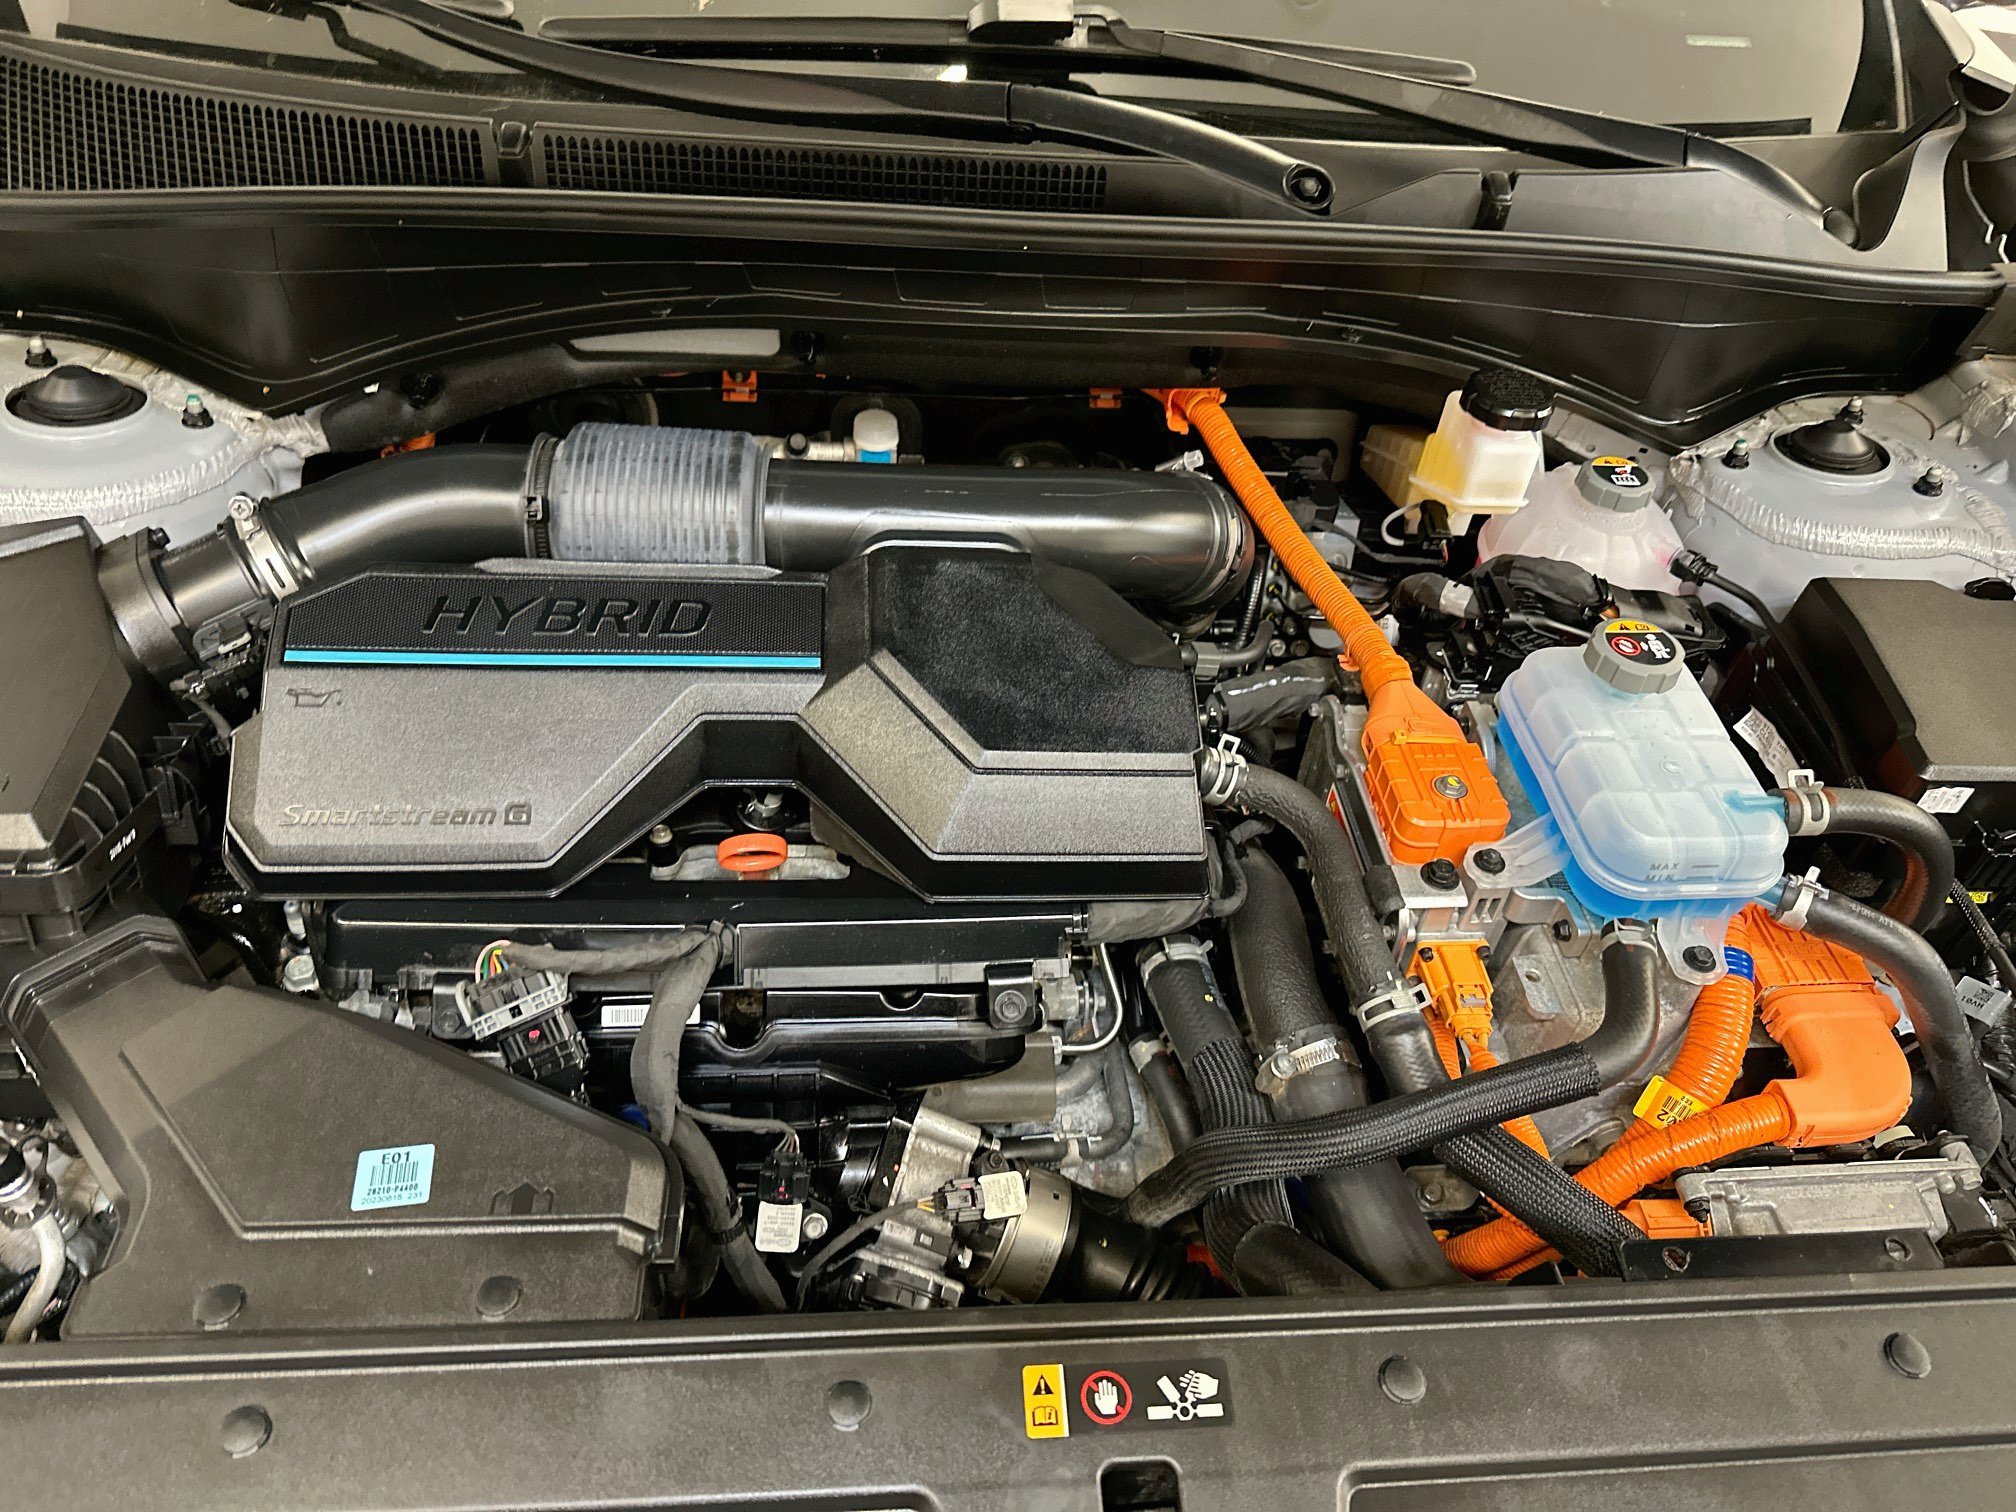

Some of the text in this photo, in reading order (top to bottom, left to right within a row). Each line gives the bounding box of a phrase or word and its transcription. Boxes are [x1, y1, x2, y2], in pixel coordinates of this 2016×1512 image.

[422, 597, 713, 637] HYBRID
[278, 801, 532, 827] Smartstream G
[1649, 862, 1680, 871] MAX
[1644, 873, 1675, 882] MIN
